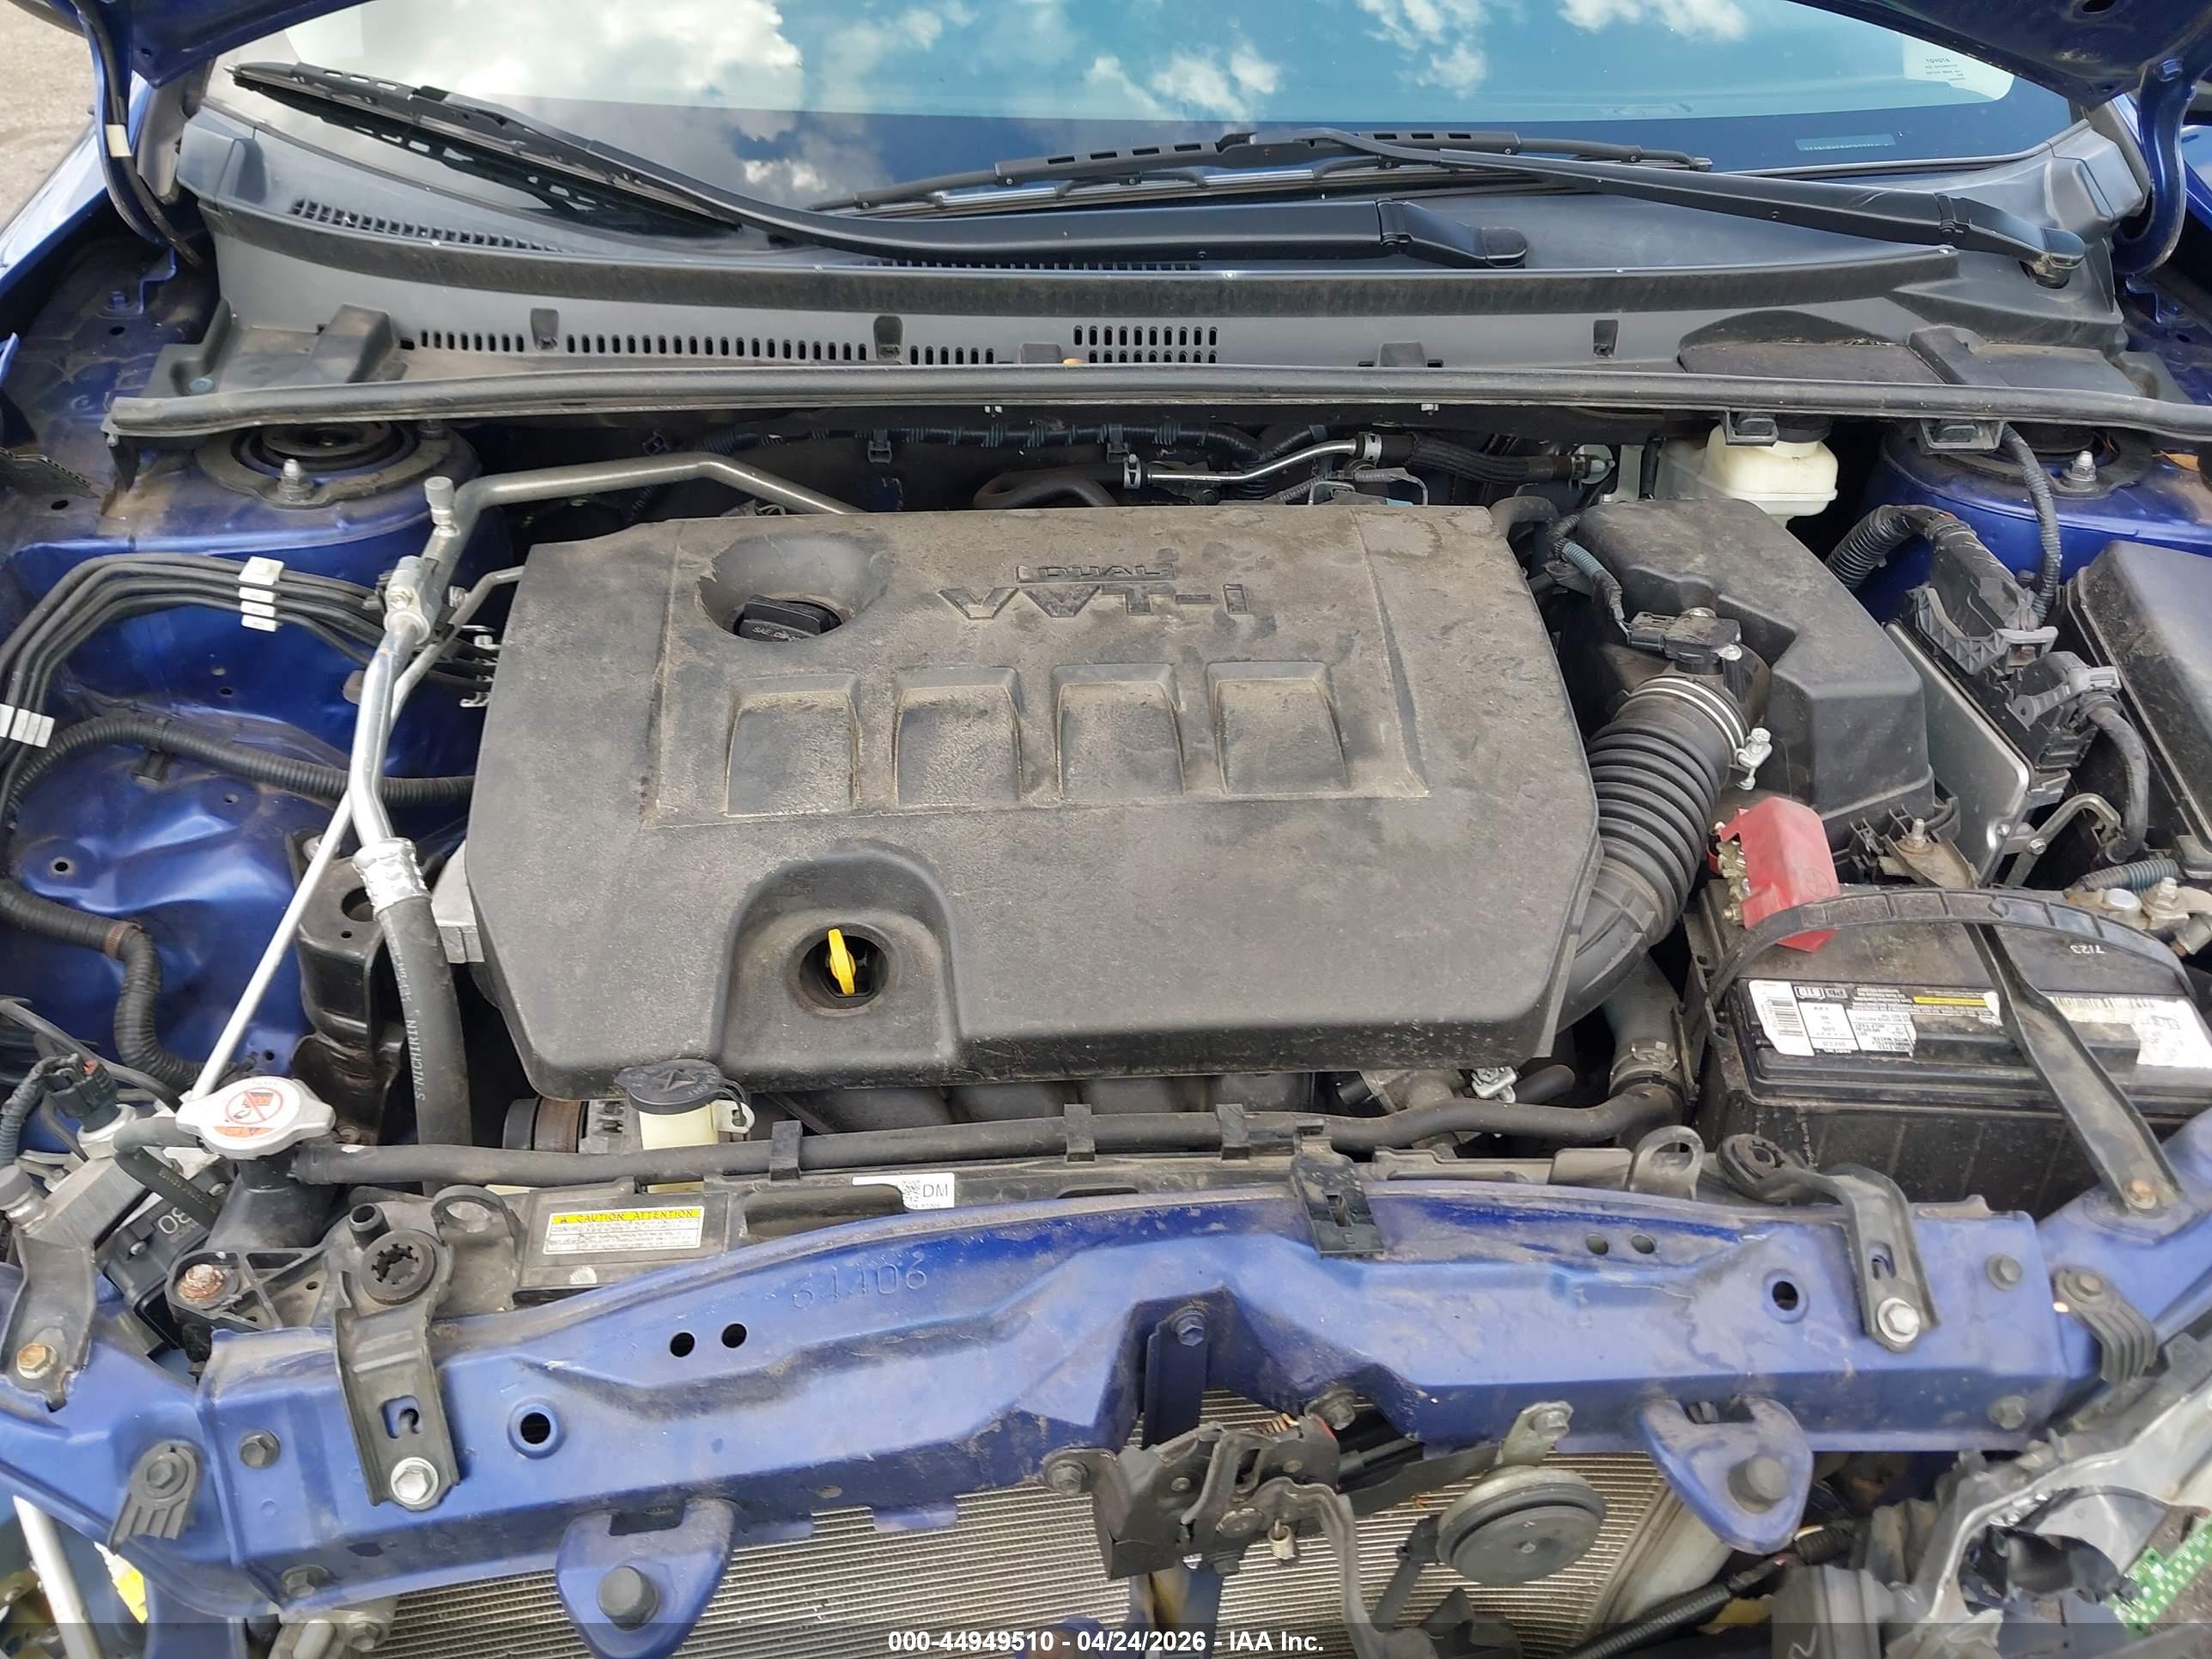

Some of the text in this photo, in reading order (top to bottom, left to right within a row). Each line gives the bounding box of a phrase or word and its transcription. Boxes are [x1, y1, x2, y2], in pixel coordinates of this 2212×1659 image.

[1039, 566, 1162, 579] DUAL
[922, 1183, 949, 1198] DM
[576, 1207, 694, 1224] CAUTION ATTENTION
